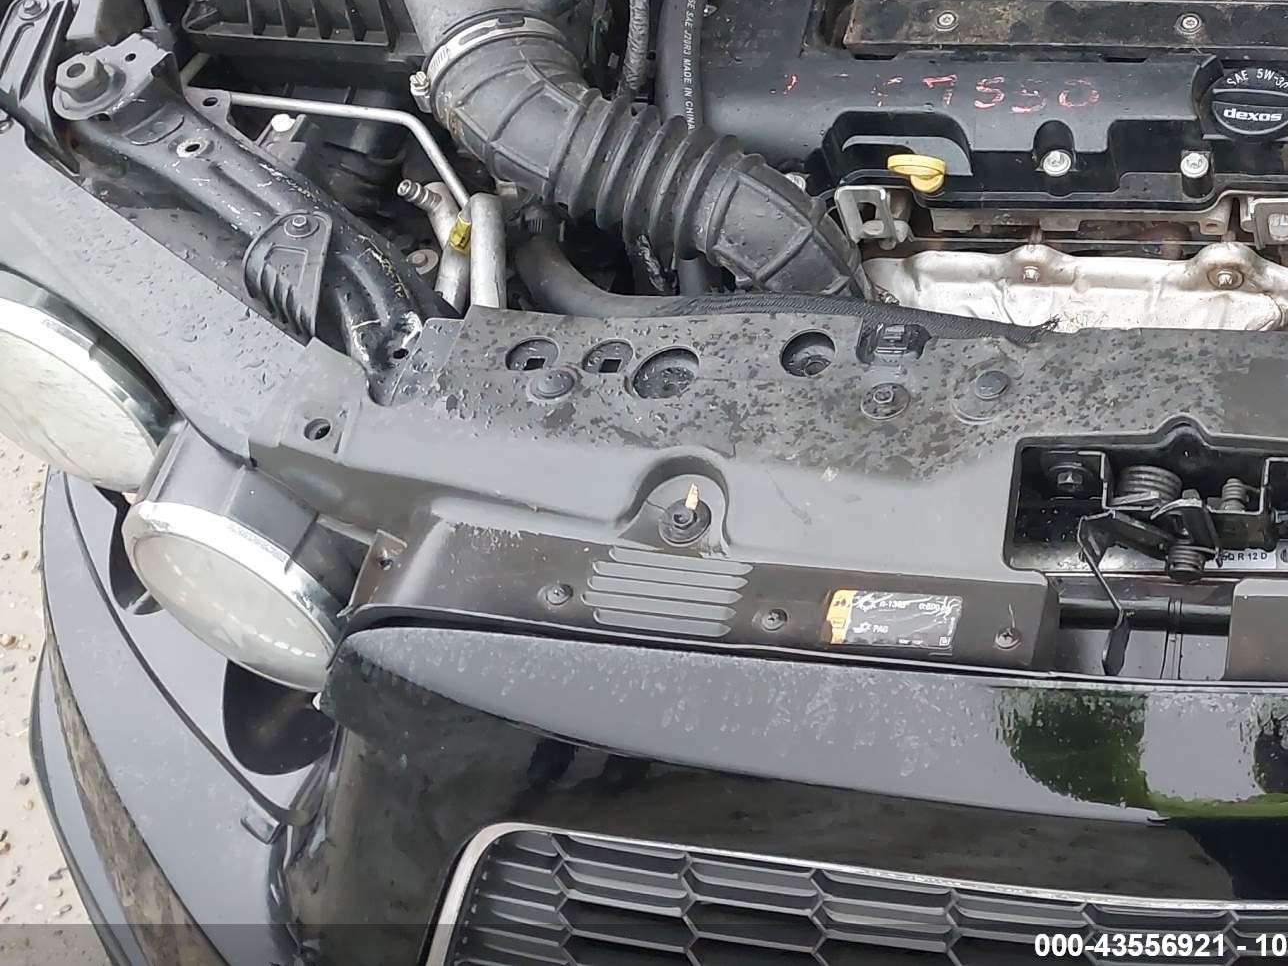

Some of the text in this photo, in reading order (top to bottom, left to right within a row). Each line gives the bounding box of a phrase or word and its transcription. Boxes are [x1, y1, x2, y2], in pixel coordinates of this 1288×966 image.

[684, 10, 695, 28] SAE
[683, 30, 694, 56] J20R3
[683, 58, 692, 85] MADE
[1226, 69, 1249, 86] SAE
[683, 87, 693, 97] IN
[684, 100, 696, 131] CHINA
[1223, 108, 1283, 122] dexos
